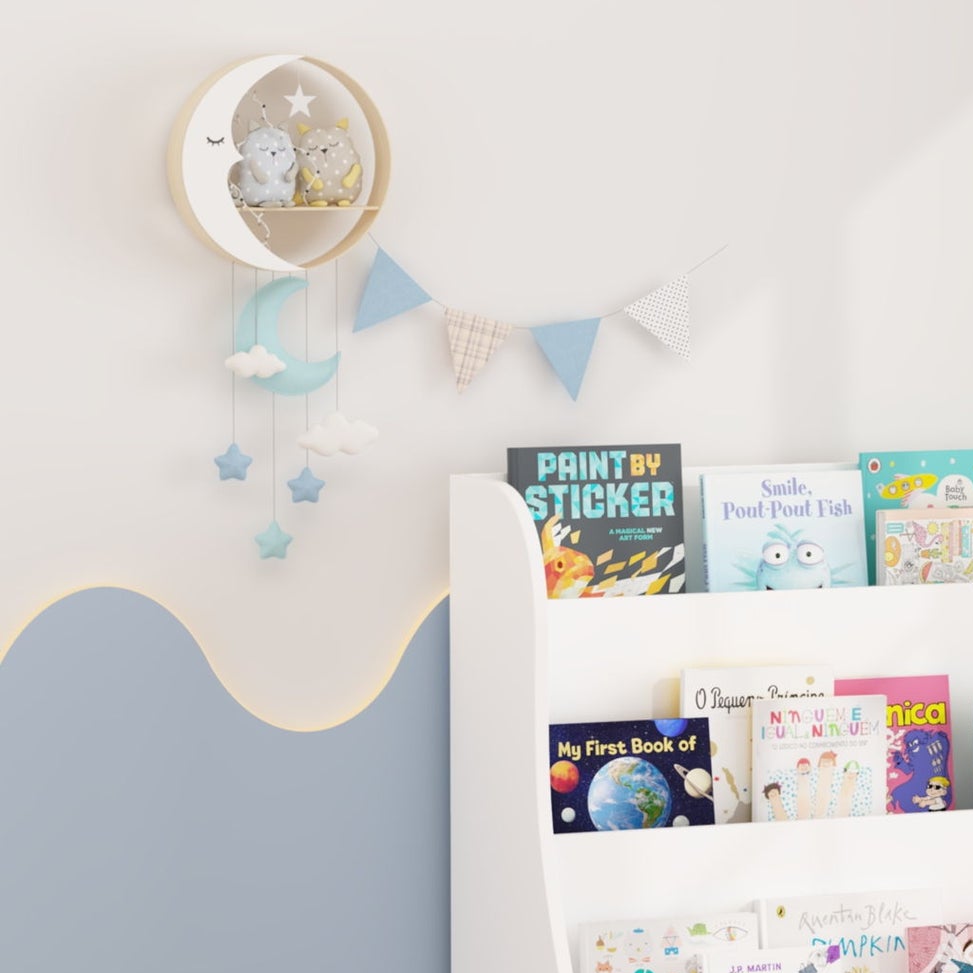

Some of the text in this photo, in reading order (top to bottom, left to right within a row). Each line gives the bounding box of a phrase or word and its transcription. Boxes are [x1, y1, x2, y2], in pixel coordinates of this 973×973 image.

[537, 450, 661, 482] PAINT BY
[761, 477, 813, 498] Smile,
[945, 485, 965, 494] Baby
[945, 493, 968, 501] Touch
[524, 481, 676, 521] STICKER
[721, 499, 853, 521] Pout-Pout Fish
[646, 526, 663, 534] NEW
[696, 688, 707, 710] O
[557, 735, 697, 761] My First Book of
[861, 901, 918, 931] Blake
[747, 963, 782, 973] MARTIN
